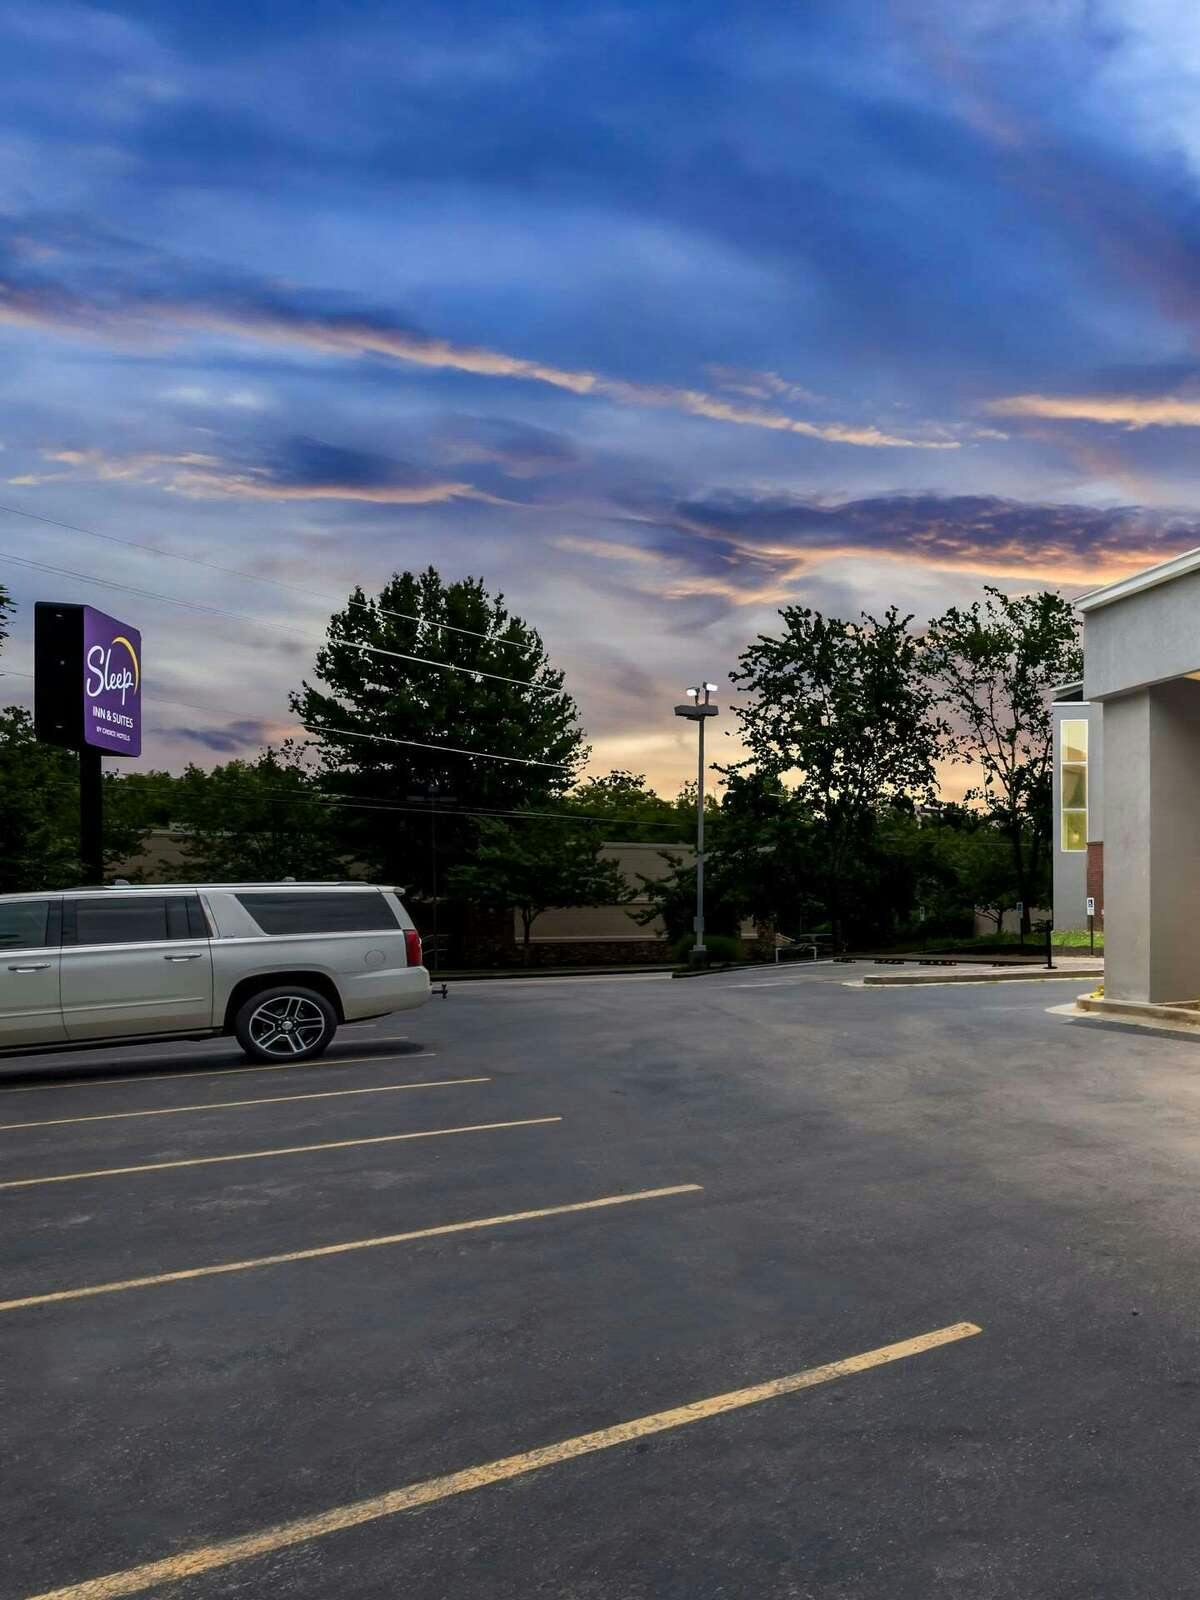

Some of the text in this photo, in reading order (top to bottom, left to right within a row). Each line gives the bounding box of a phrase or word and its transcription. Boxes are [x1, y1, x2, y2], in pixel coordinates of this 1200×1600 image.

[86, 645, 134, 706] Sleep
[92, 705, 134, 729] INN & SUITES
